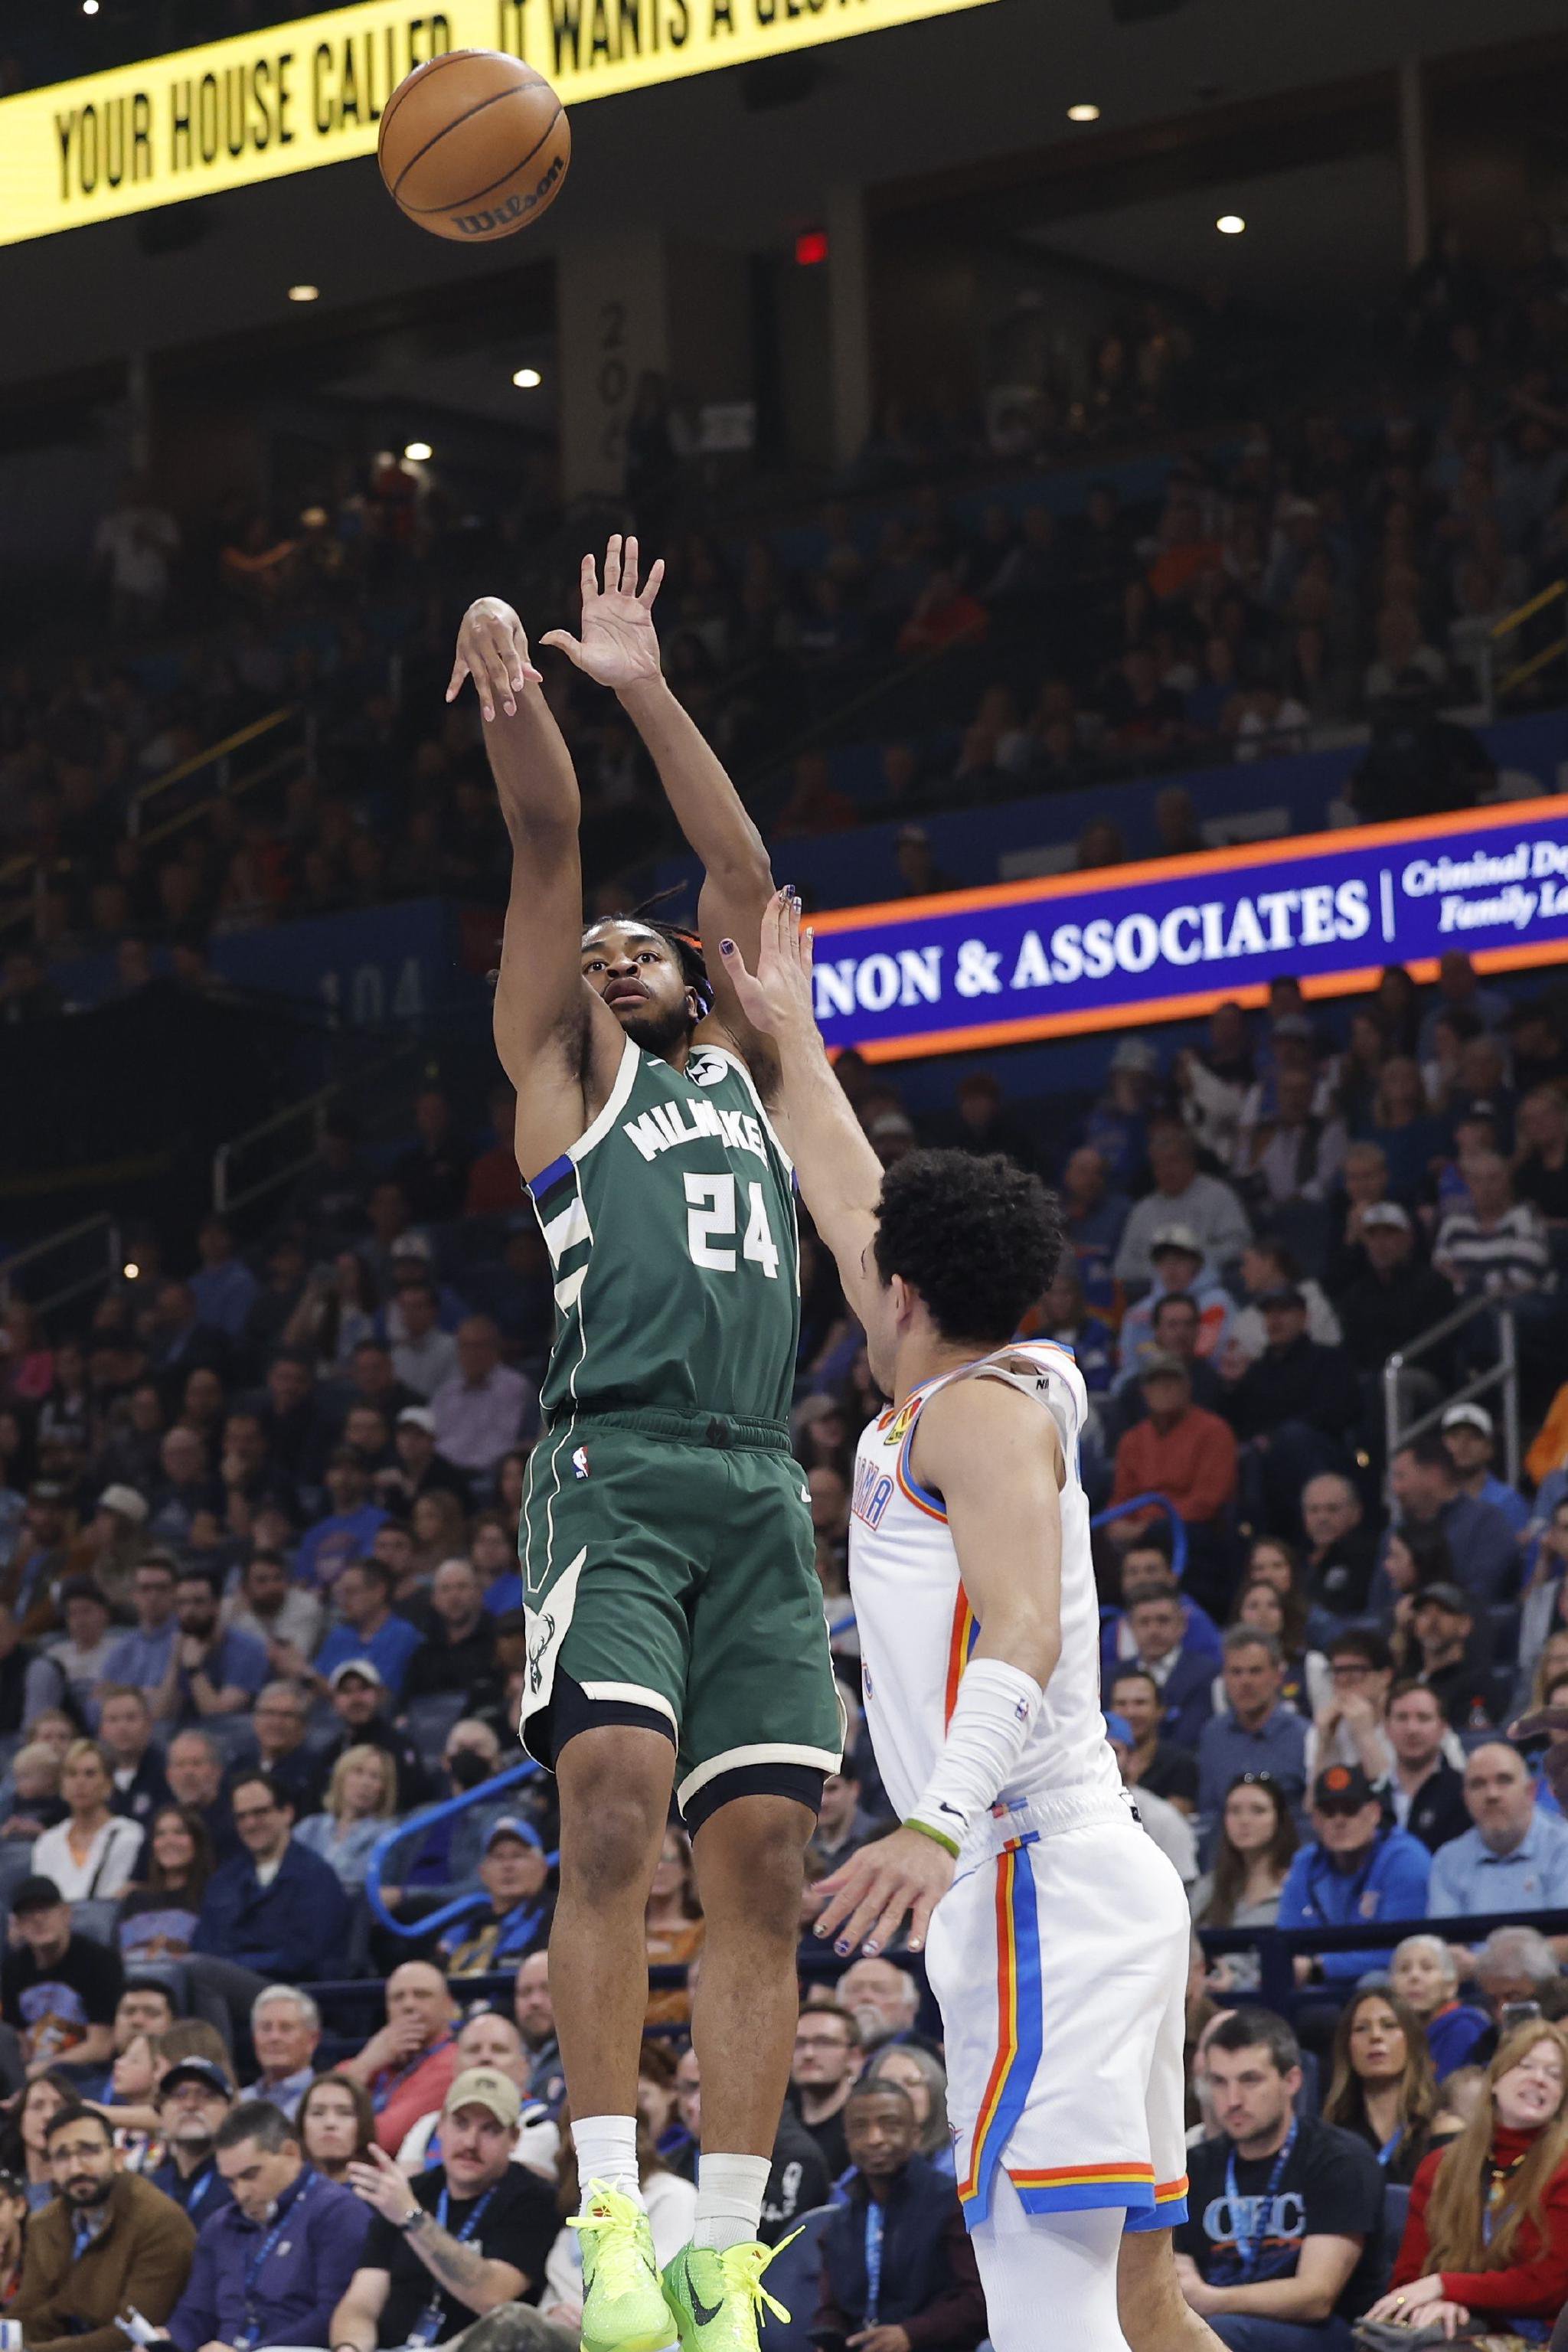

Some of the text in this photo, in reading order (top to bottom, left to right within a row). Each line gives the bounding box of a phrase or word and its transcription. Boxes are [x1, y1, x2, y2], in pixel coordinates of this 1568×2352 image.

[54, 91, 153, 201] YOUR
[169, 52, 295, 172] HOUSE
[450, 155, 564, 234] Wilson
[1402, 841, 1530, 897] Criminal
[1438, 884, 1538, 933] Family
[955, 939, 1003, 998] &
[1009, 879, 1372, 990] ASSOCIATES
[683, 1172, 779, 1279] 24
